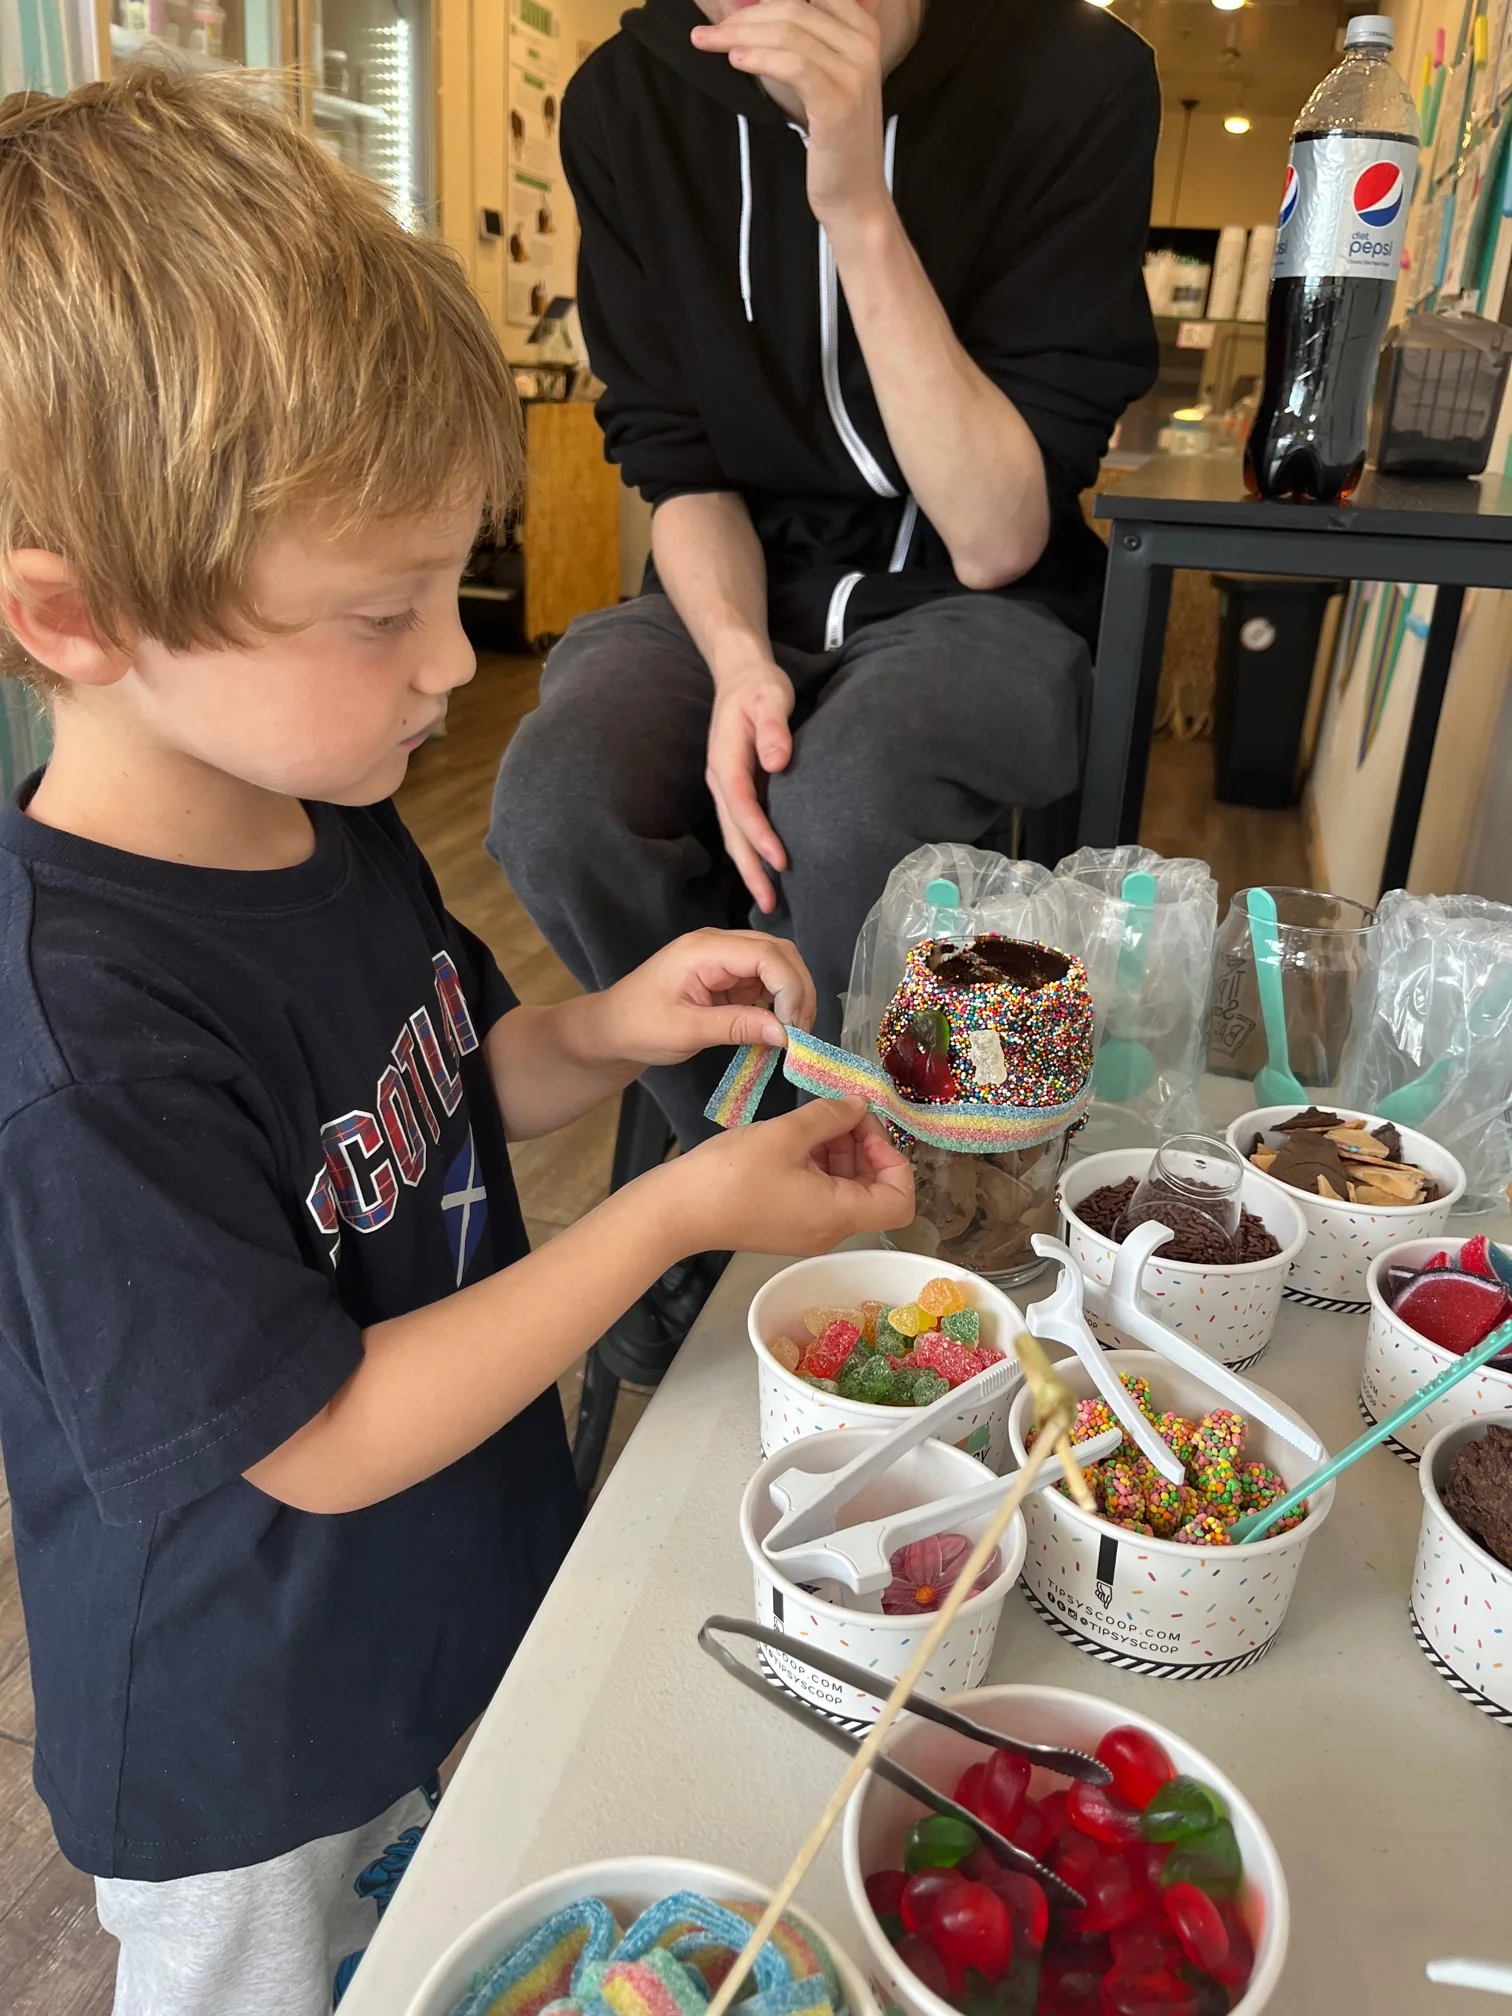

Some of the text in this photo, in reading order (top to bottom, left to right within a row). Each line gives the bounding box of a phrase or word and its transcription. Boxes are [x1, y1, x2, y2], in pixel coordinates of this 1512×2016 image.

[1352, 232, 1369, 240] diet
[1349, 240, 1394, 258] pepsi
[1047, 1577, 1181, 1642] TIPSYSCOOP.COM
